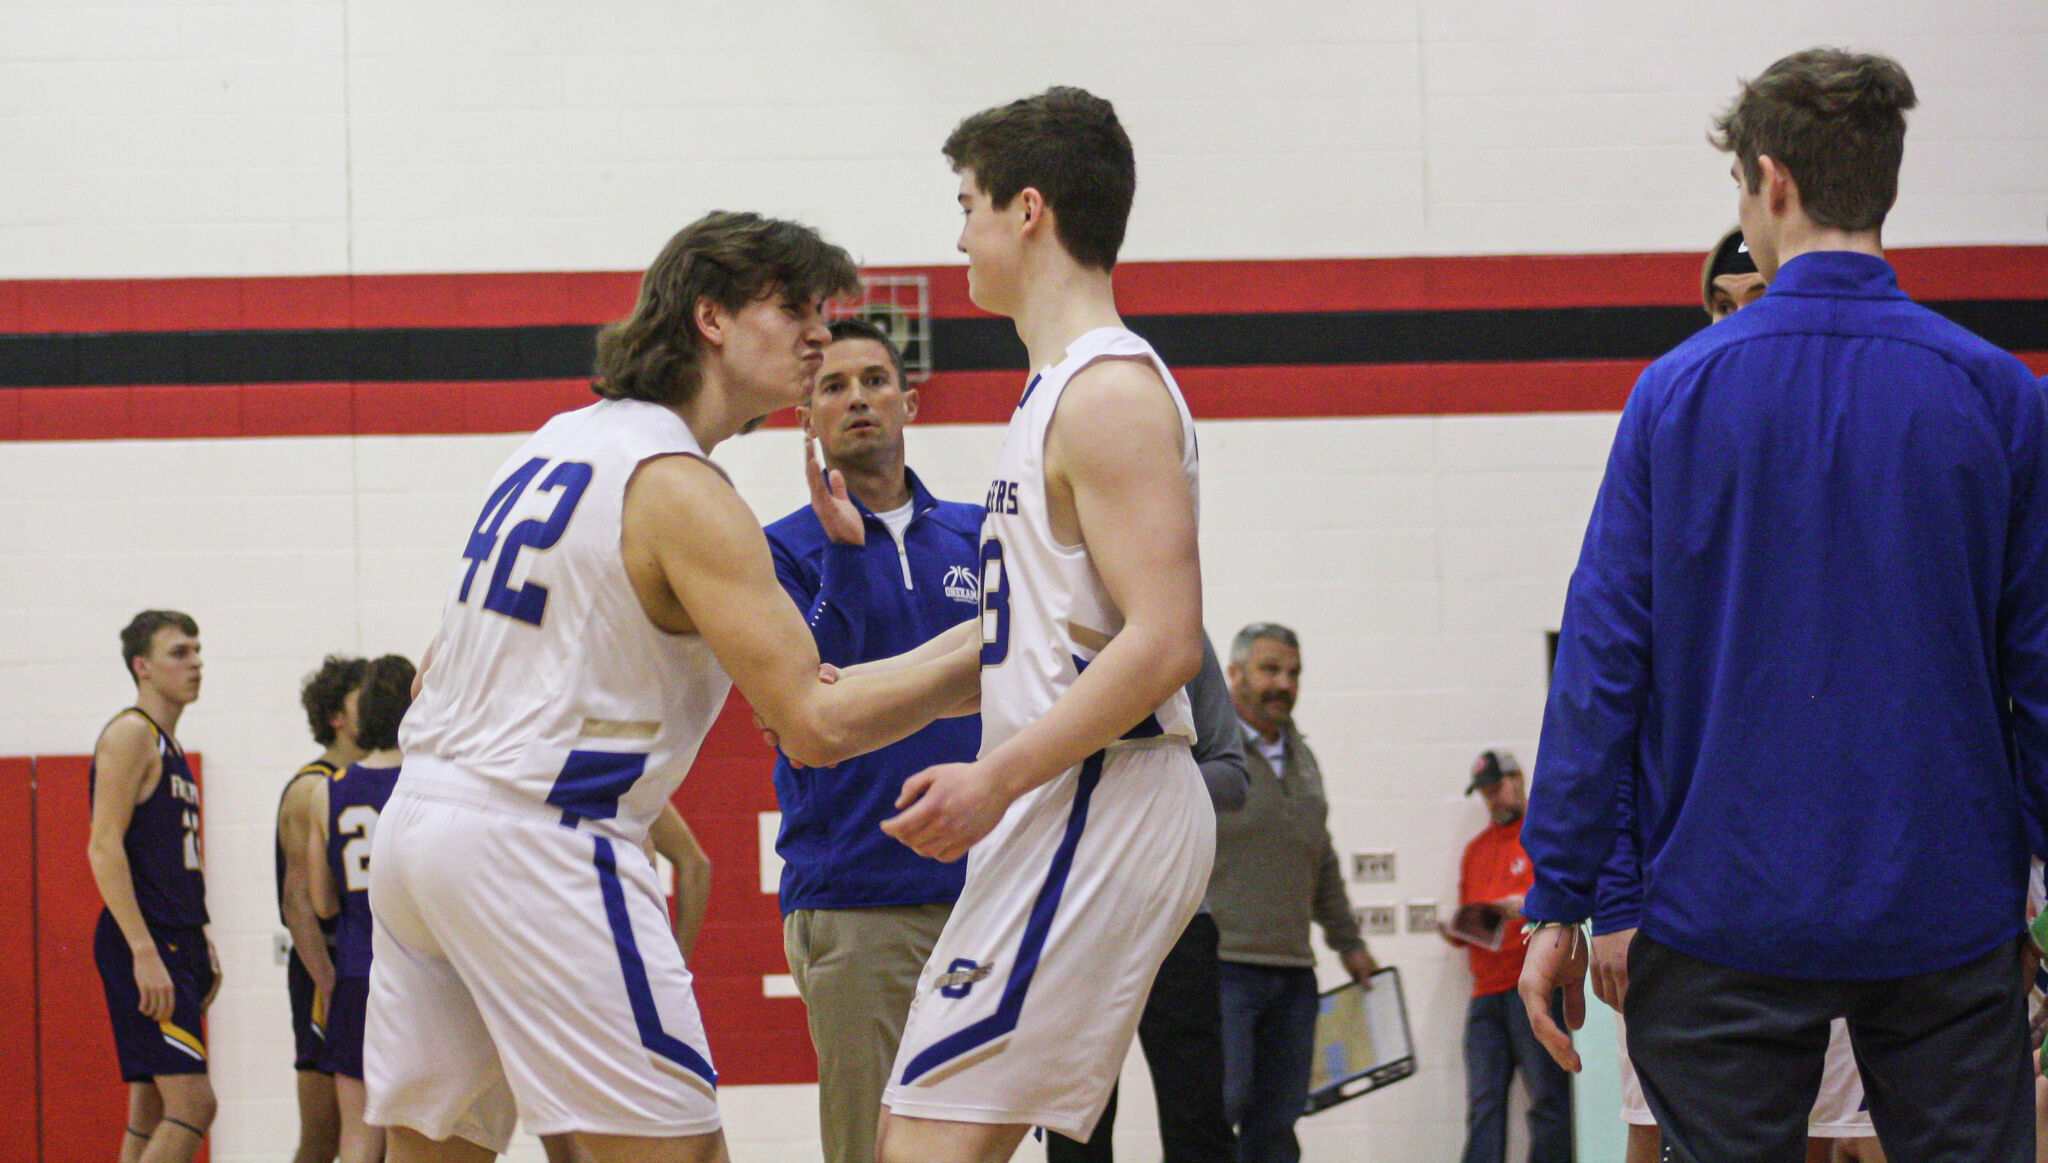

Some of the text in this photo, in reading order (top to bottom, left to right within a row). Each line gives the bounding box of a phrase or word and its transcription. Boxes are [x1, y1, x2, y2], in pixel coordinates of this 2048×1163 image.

[984, 480, 1018, 514] ERS
[458, 456, 594, 627] 42
[338, 805, 380, 891] 2
